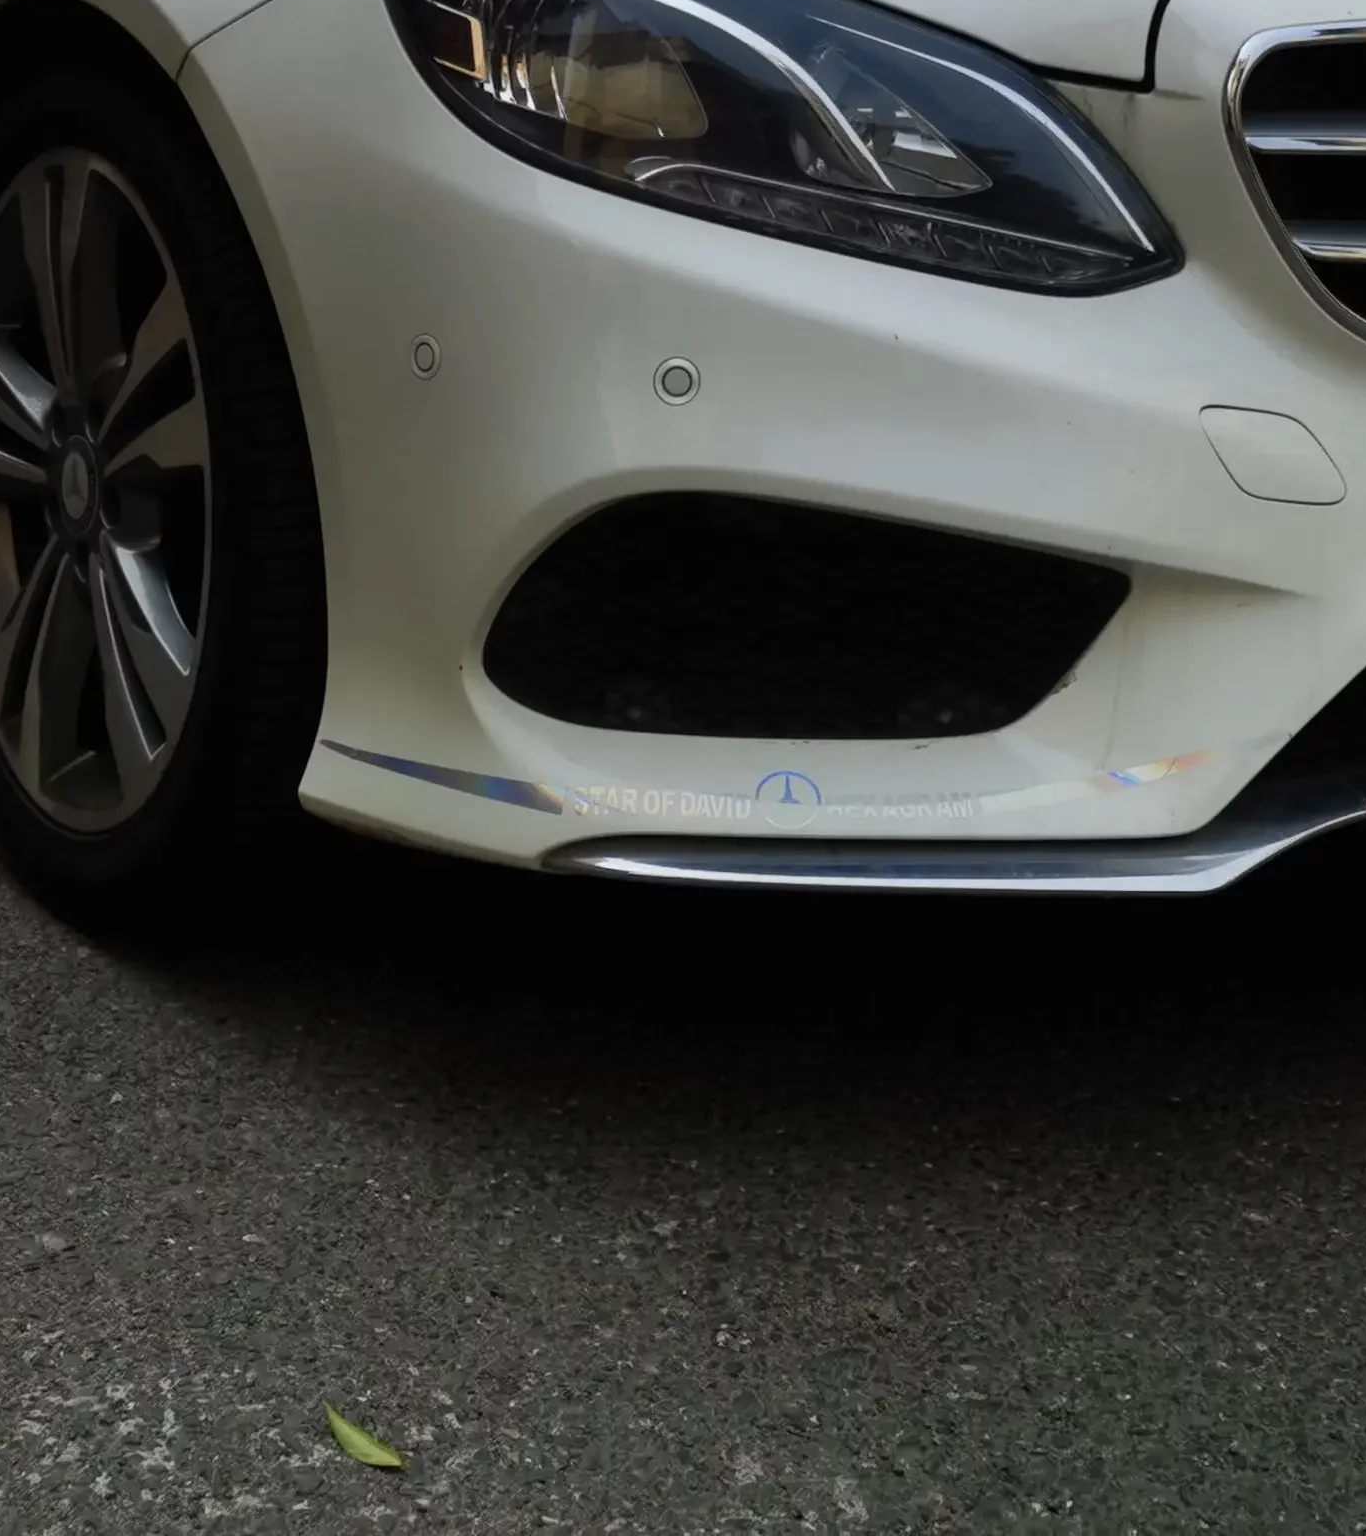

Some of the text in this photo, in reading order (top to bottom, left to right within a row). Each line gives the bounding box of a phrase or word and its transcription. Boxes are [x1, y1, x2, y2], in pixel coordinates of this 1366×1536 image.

[574, 786, 638, 816] STAR
[642, 789, 676, 816] OF
[680, 792, 752, 820] DAVID
